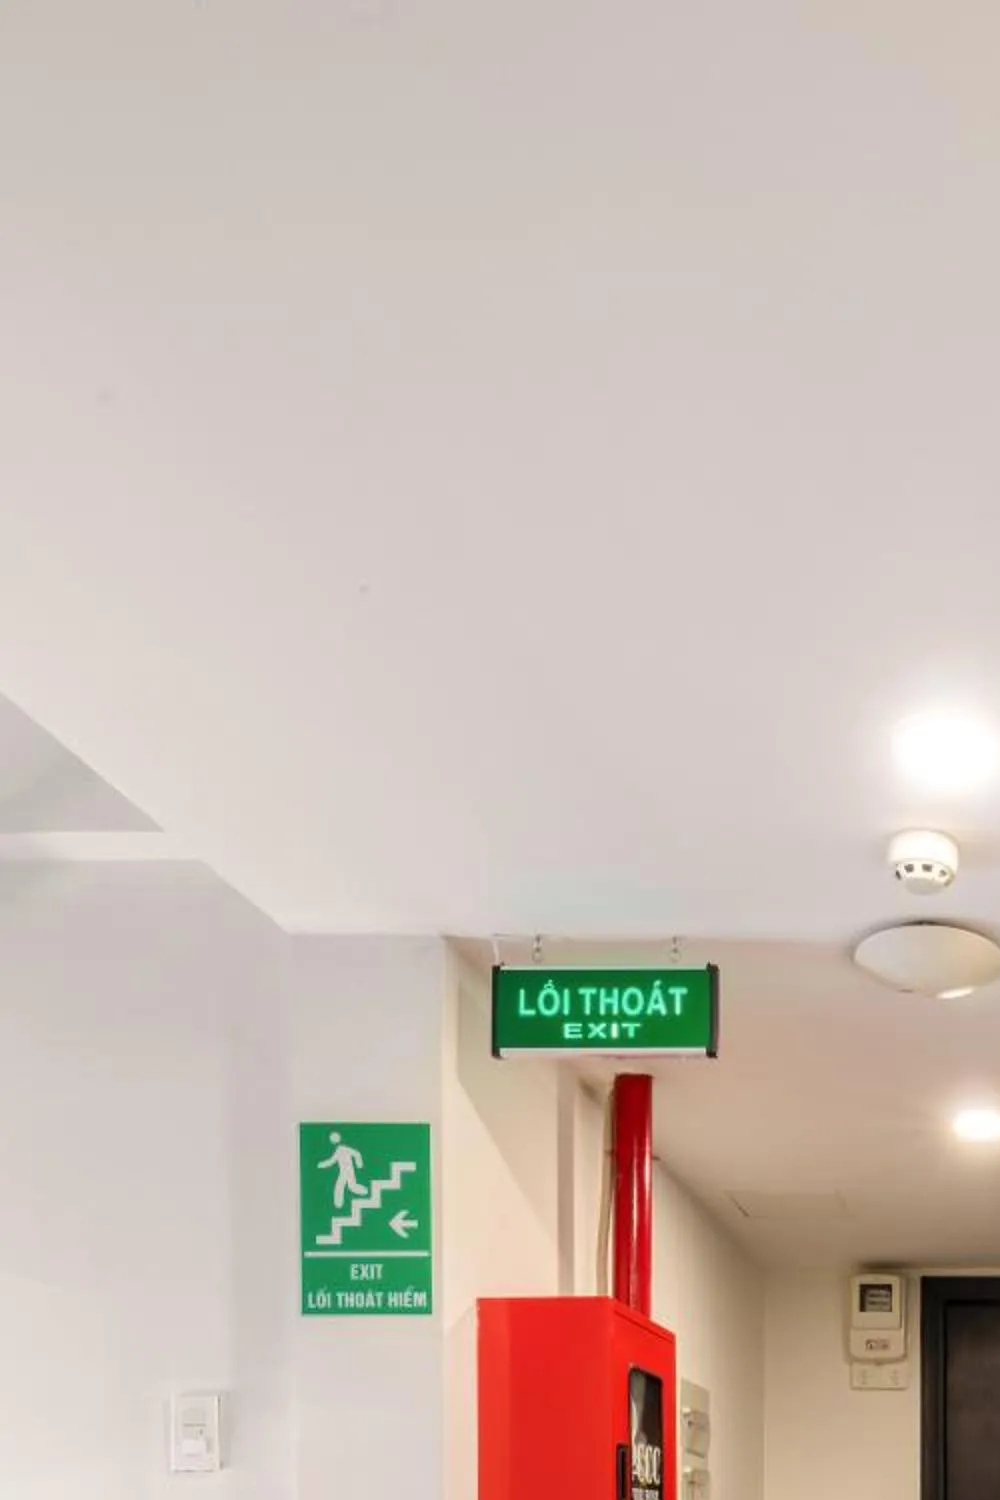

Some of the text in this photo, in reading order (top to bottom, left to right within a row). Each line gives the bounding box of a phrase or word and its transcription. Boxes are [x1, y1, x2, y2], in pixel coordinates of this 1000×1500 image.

[518, 979, 689, 1017] LỐI THOÁT
[563, 1022, 642, 1039] EXIT
[350, 1263, 384, 1280] EXIT
[335, 1289, 384, 1309] THOÁT
